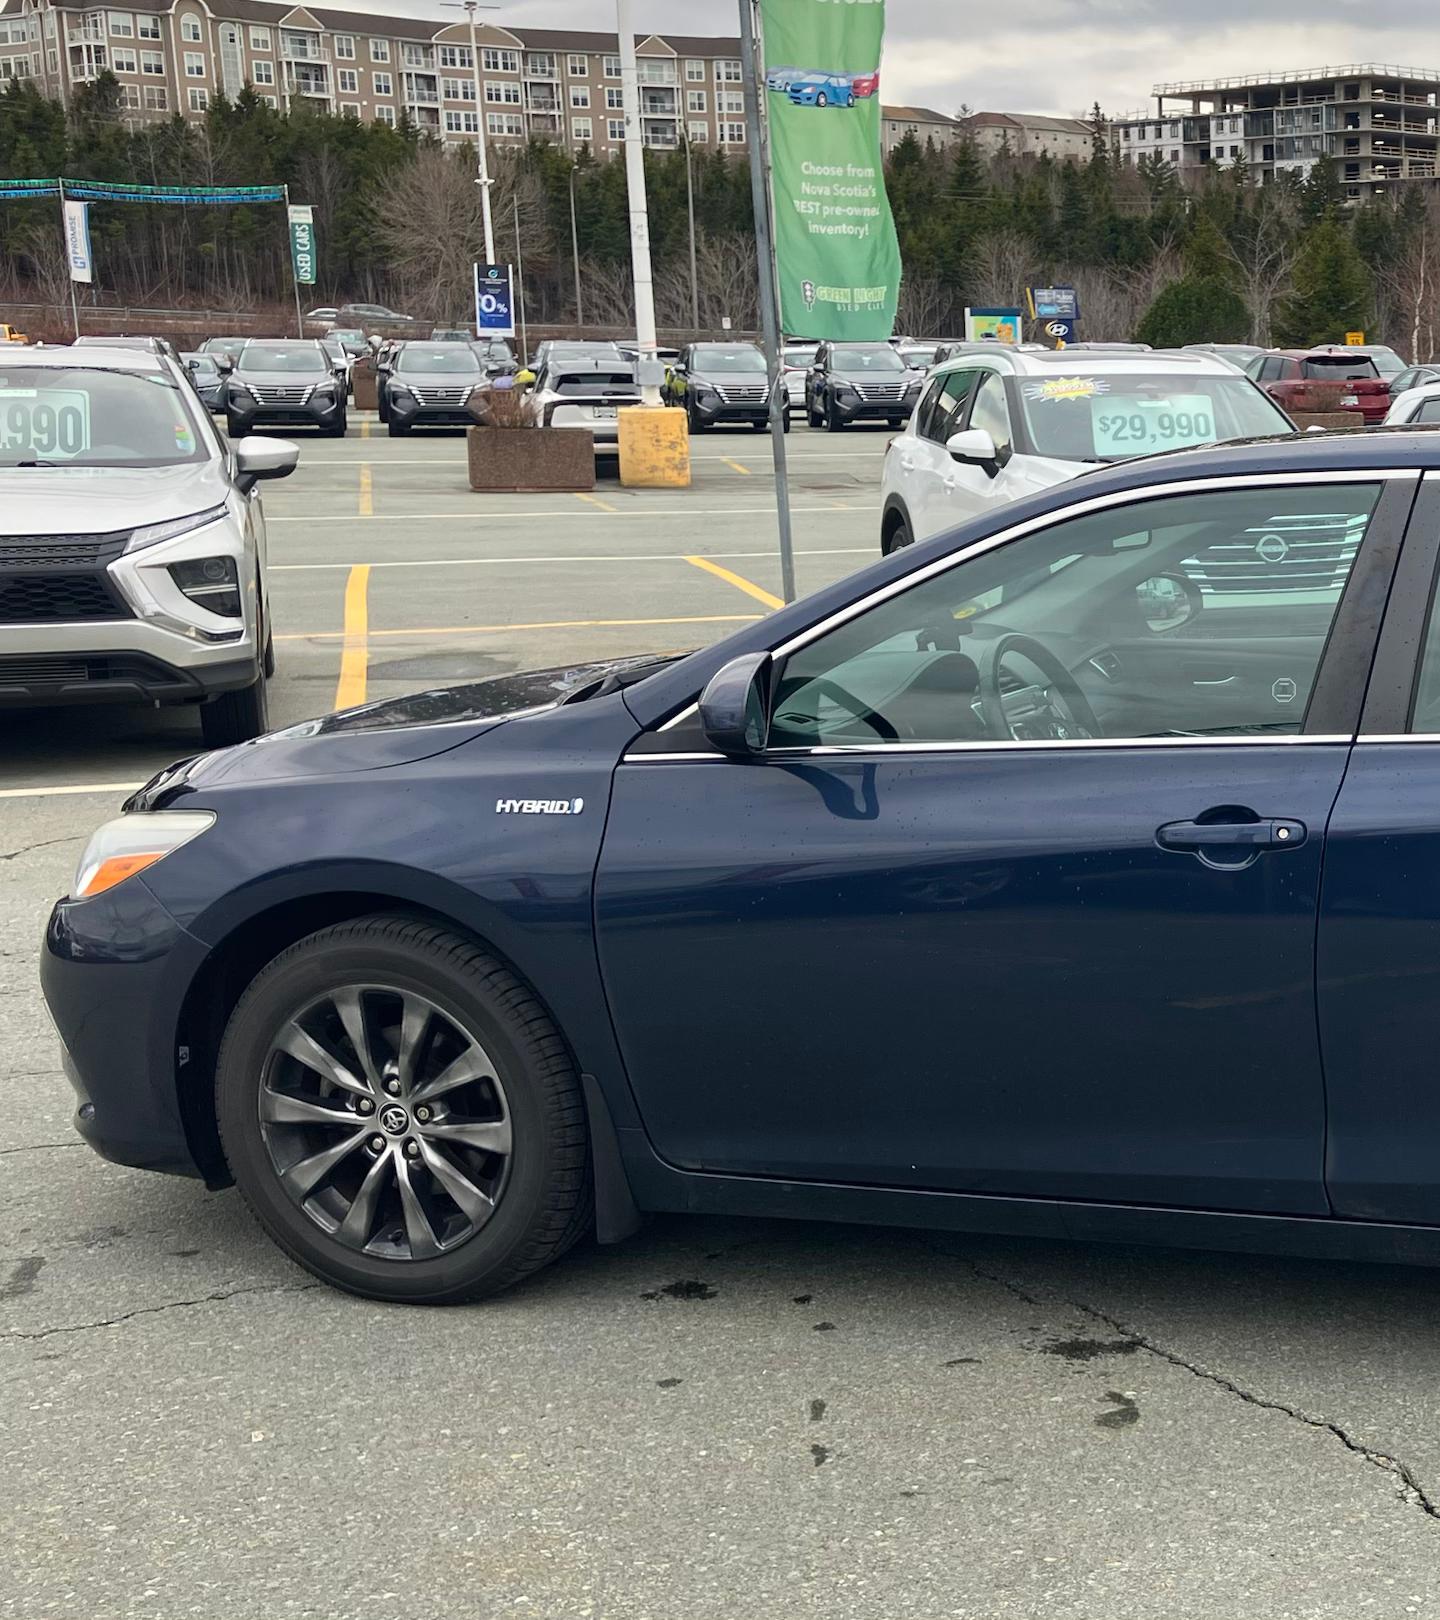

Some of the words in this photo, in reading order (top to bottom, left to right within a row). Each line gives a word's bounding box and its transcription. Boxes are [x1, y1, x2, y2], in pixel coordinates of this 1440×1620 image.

[801, 161, 843, 176] Choose
[846, 163, 875, 177] from
[801, 182, 830, 195] Nova
[833, 183, 876, 197] Scotia's
[69, 216, 79, 255] PROMISE
[295, 224, 310, 251] CARS
[808, 221, 869, 239] inventory!
[296, 253, 311, 280] USED
[480, 294, 508, 313] 0%
[817, 286, 850, 303] GREEN
[854, 286, 887, 303] LIGHT
[1099, 413, 1211, 443] $29,990
[496, 800, 570, 814] HYBRID
